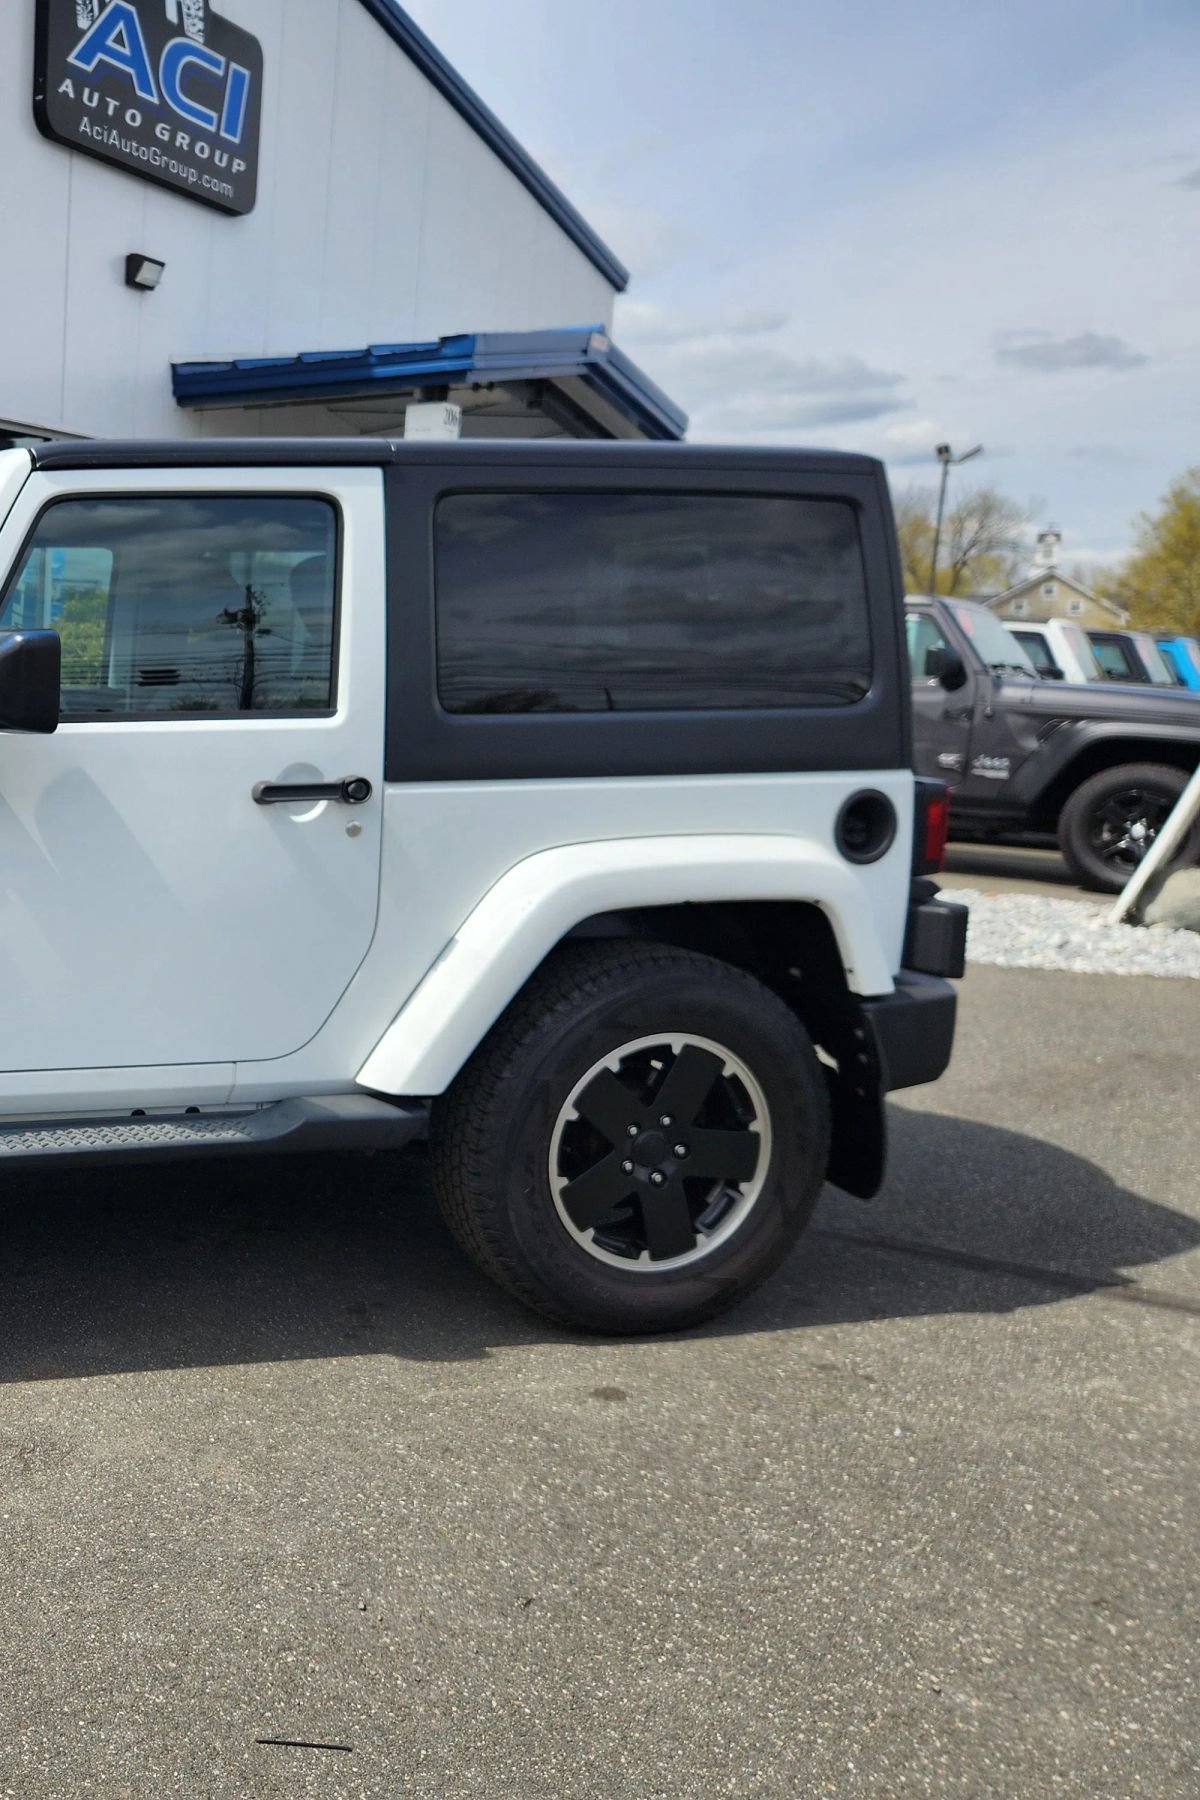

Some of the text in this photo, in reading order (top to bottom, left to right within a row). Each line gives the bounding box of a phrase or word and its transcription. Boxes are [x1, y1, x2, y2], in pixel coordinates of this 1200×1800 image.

[67, 0, 251, 144] ACI
[57, 78, 248, 174] AUTO GROUP
[78, 116, 235, 198] AciAutoGroup.com
